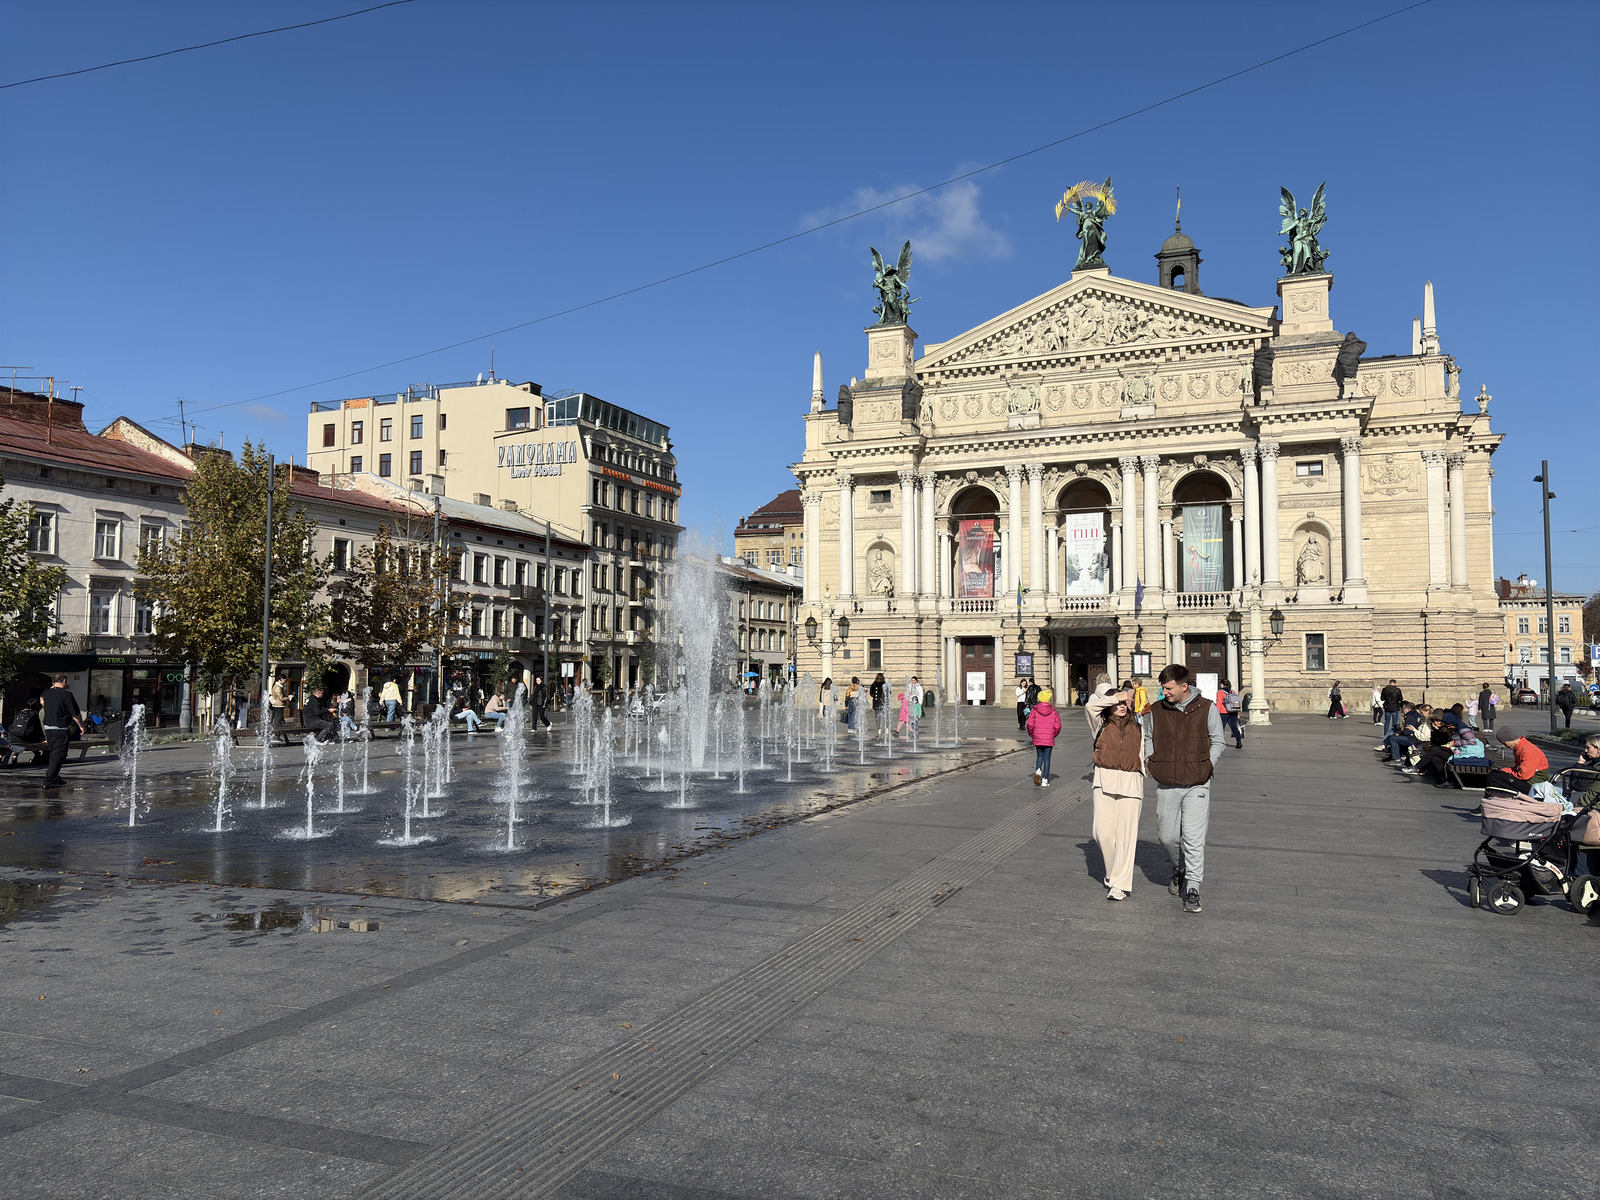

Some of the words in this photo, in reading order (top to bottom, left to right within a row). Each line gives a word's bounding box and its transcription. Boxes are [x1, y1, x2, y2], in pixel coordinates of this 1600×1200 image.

[497, 441, 577, 467] PANORAMA
[510, 466, 532, 478] Lviv
[533, 464, 562, 477] Hotel
